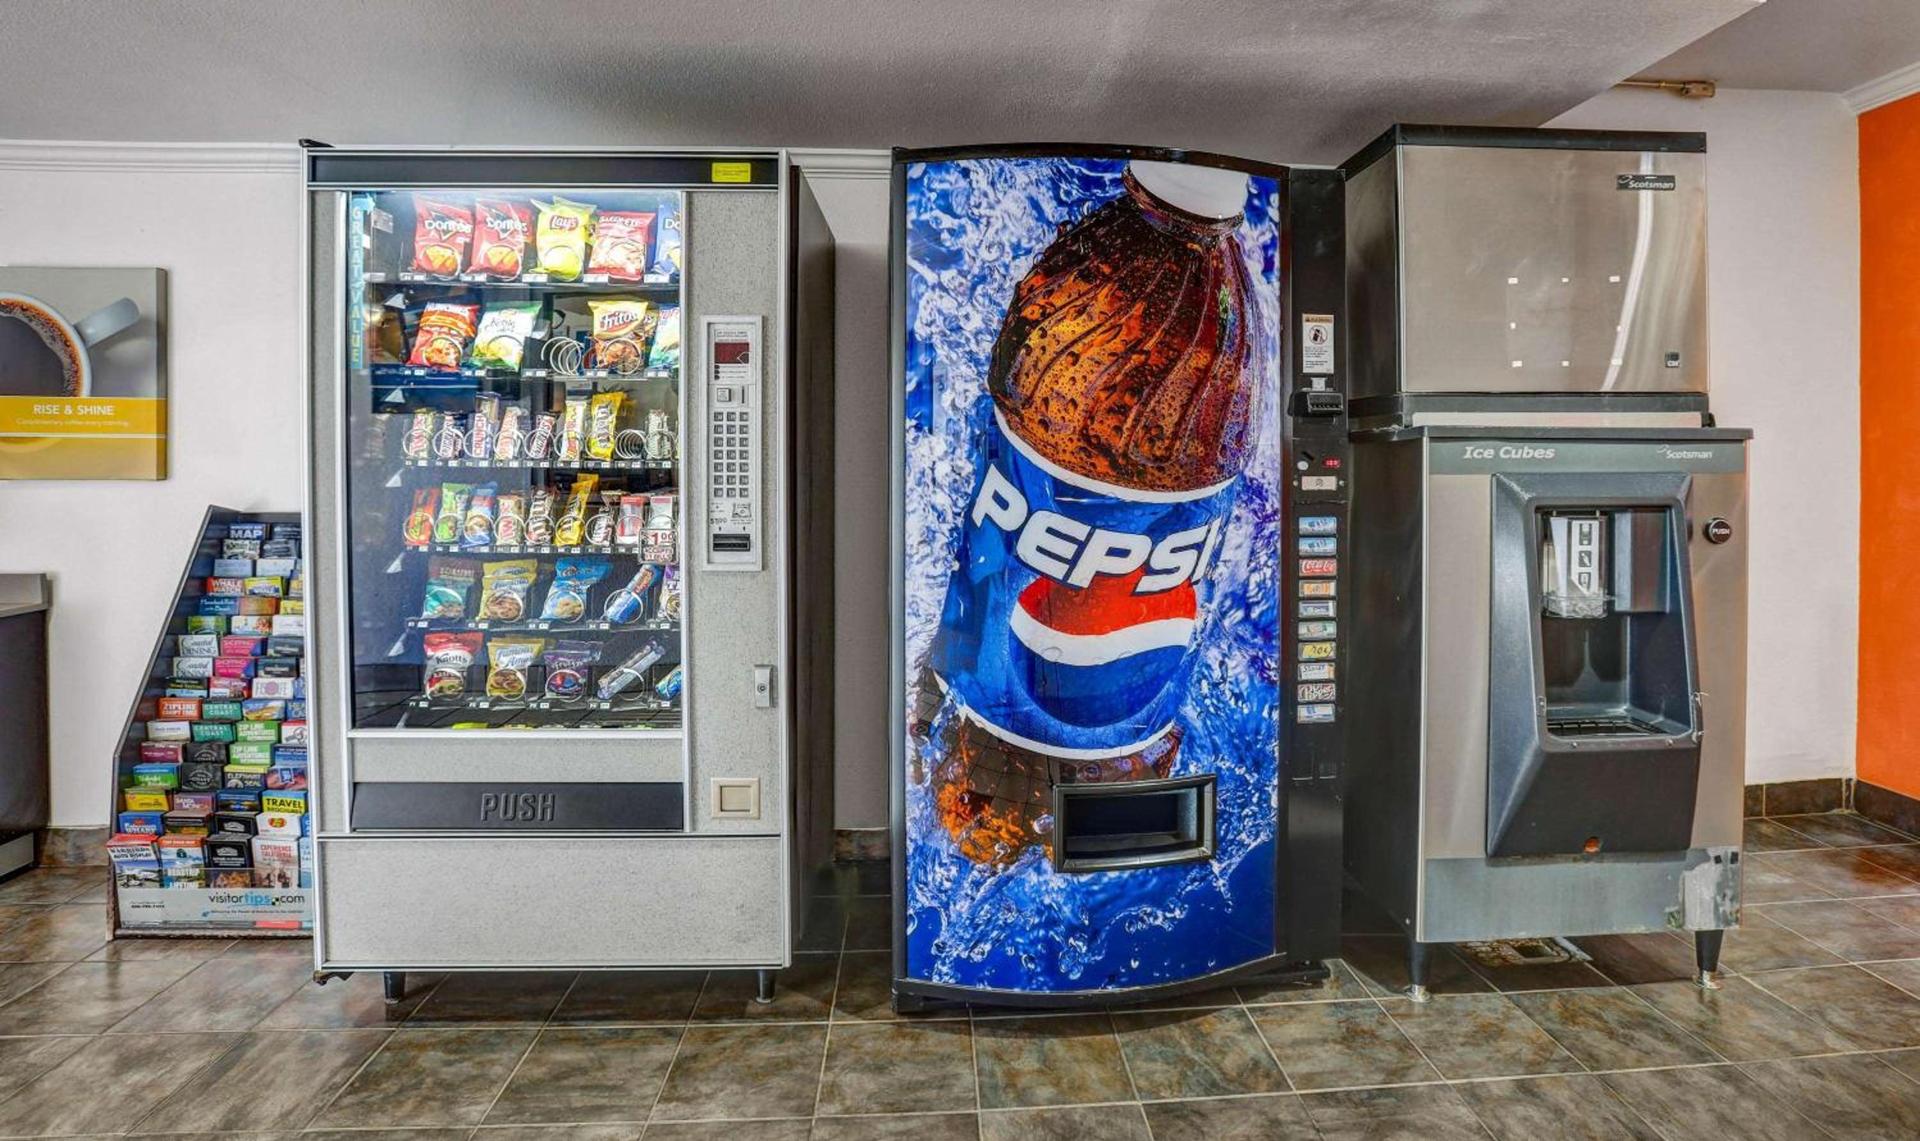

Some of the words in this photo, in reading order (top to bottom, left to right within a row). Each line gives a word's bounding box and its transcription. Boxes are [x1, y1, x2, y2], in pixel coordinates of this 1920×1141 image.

[1627, 180, 1675, 189] Scotsman
[33, 404, 60, 416] RISE
[64, 404, 73, 416] &
[77, 404, 115, 416] SHINE
[1463, 446, 1495, 460] Ice
[1499, 446, 1556, 460] Cubes
[1666, 449, 1713, 460] Scotsman
[972, 463, 1222, 593] PEPSI
[230, 529, 263, 539] MAP
[266, 798, 303, 809] TRAVEL
[480, 792, 555, 821] PUSH
